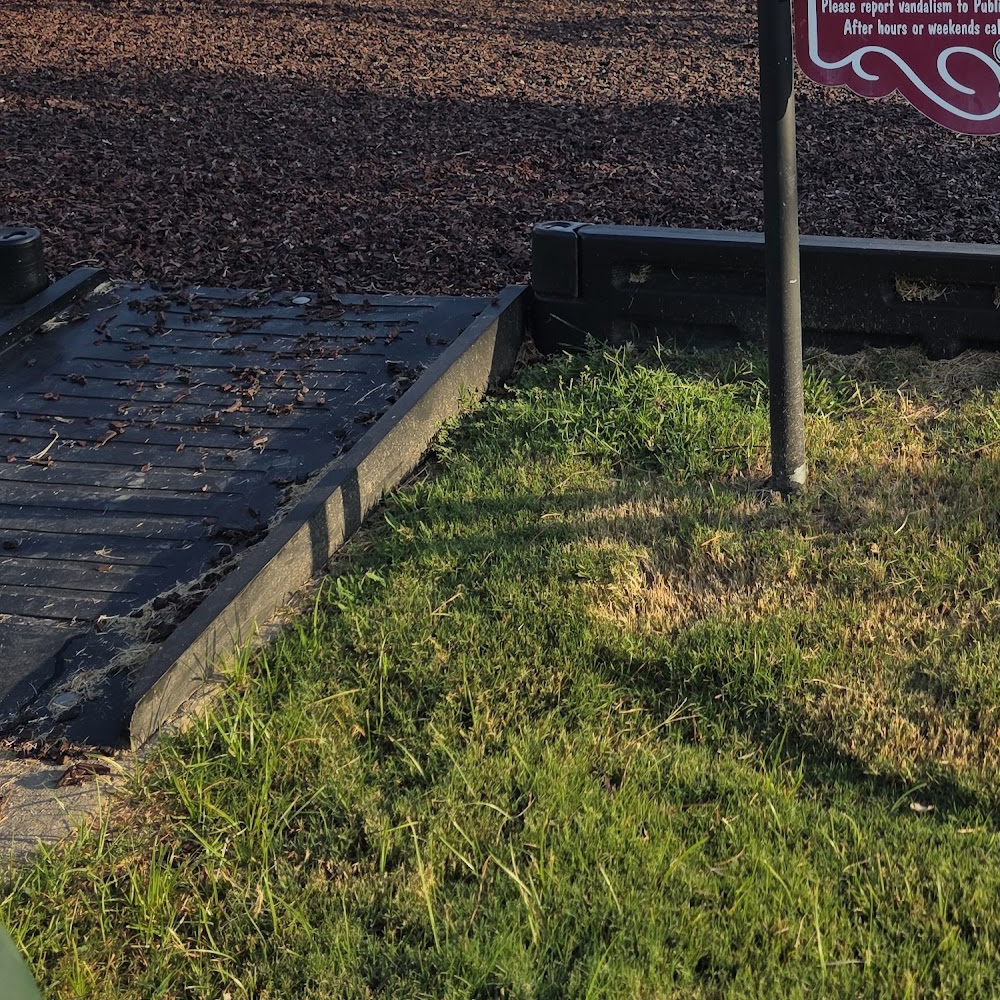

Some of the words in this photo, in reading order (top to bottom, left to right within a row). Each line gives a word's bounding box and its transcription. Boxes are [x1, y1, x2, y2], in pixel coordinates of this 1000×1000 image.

[861, 0, 894, 17] report
[957, 0, 968, 13] to
[844, 18, 873, 35] After
[878, 19, 907, 35] hours
[912, 24, 924, 35] or
[928, 18, 980, 35] weekends
